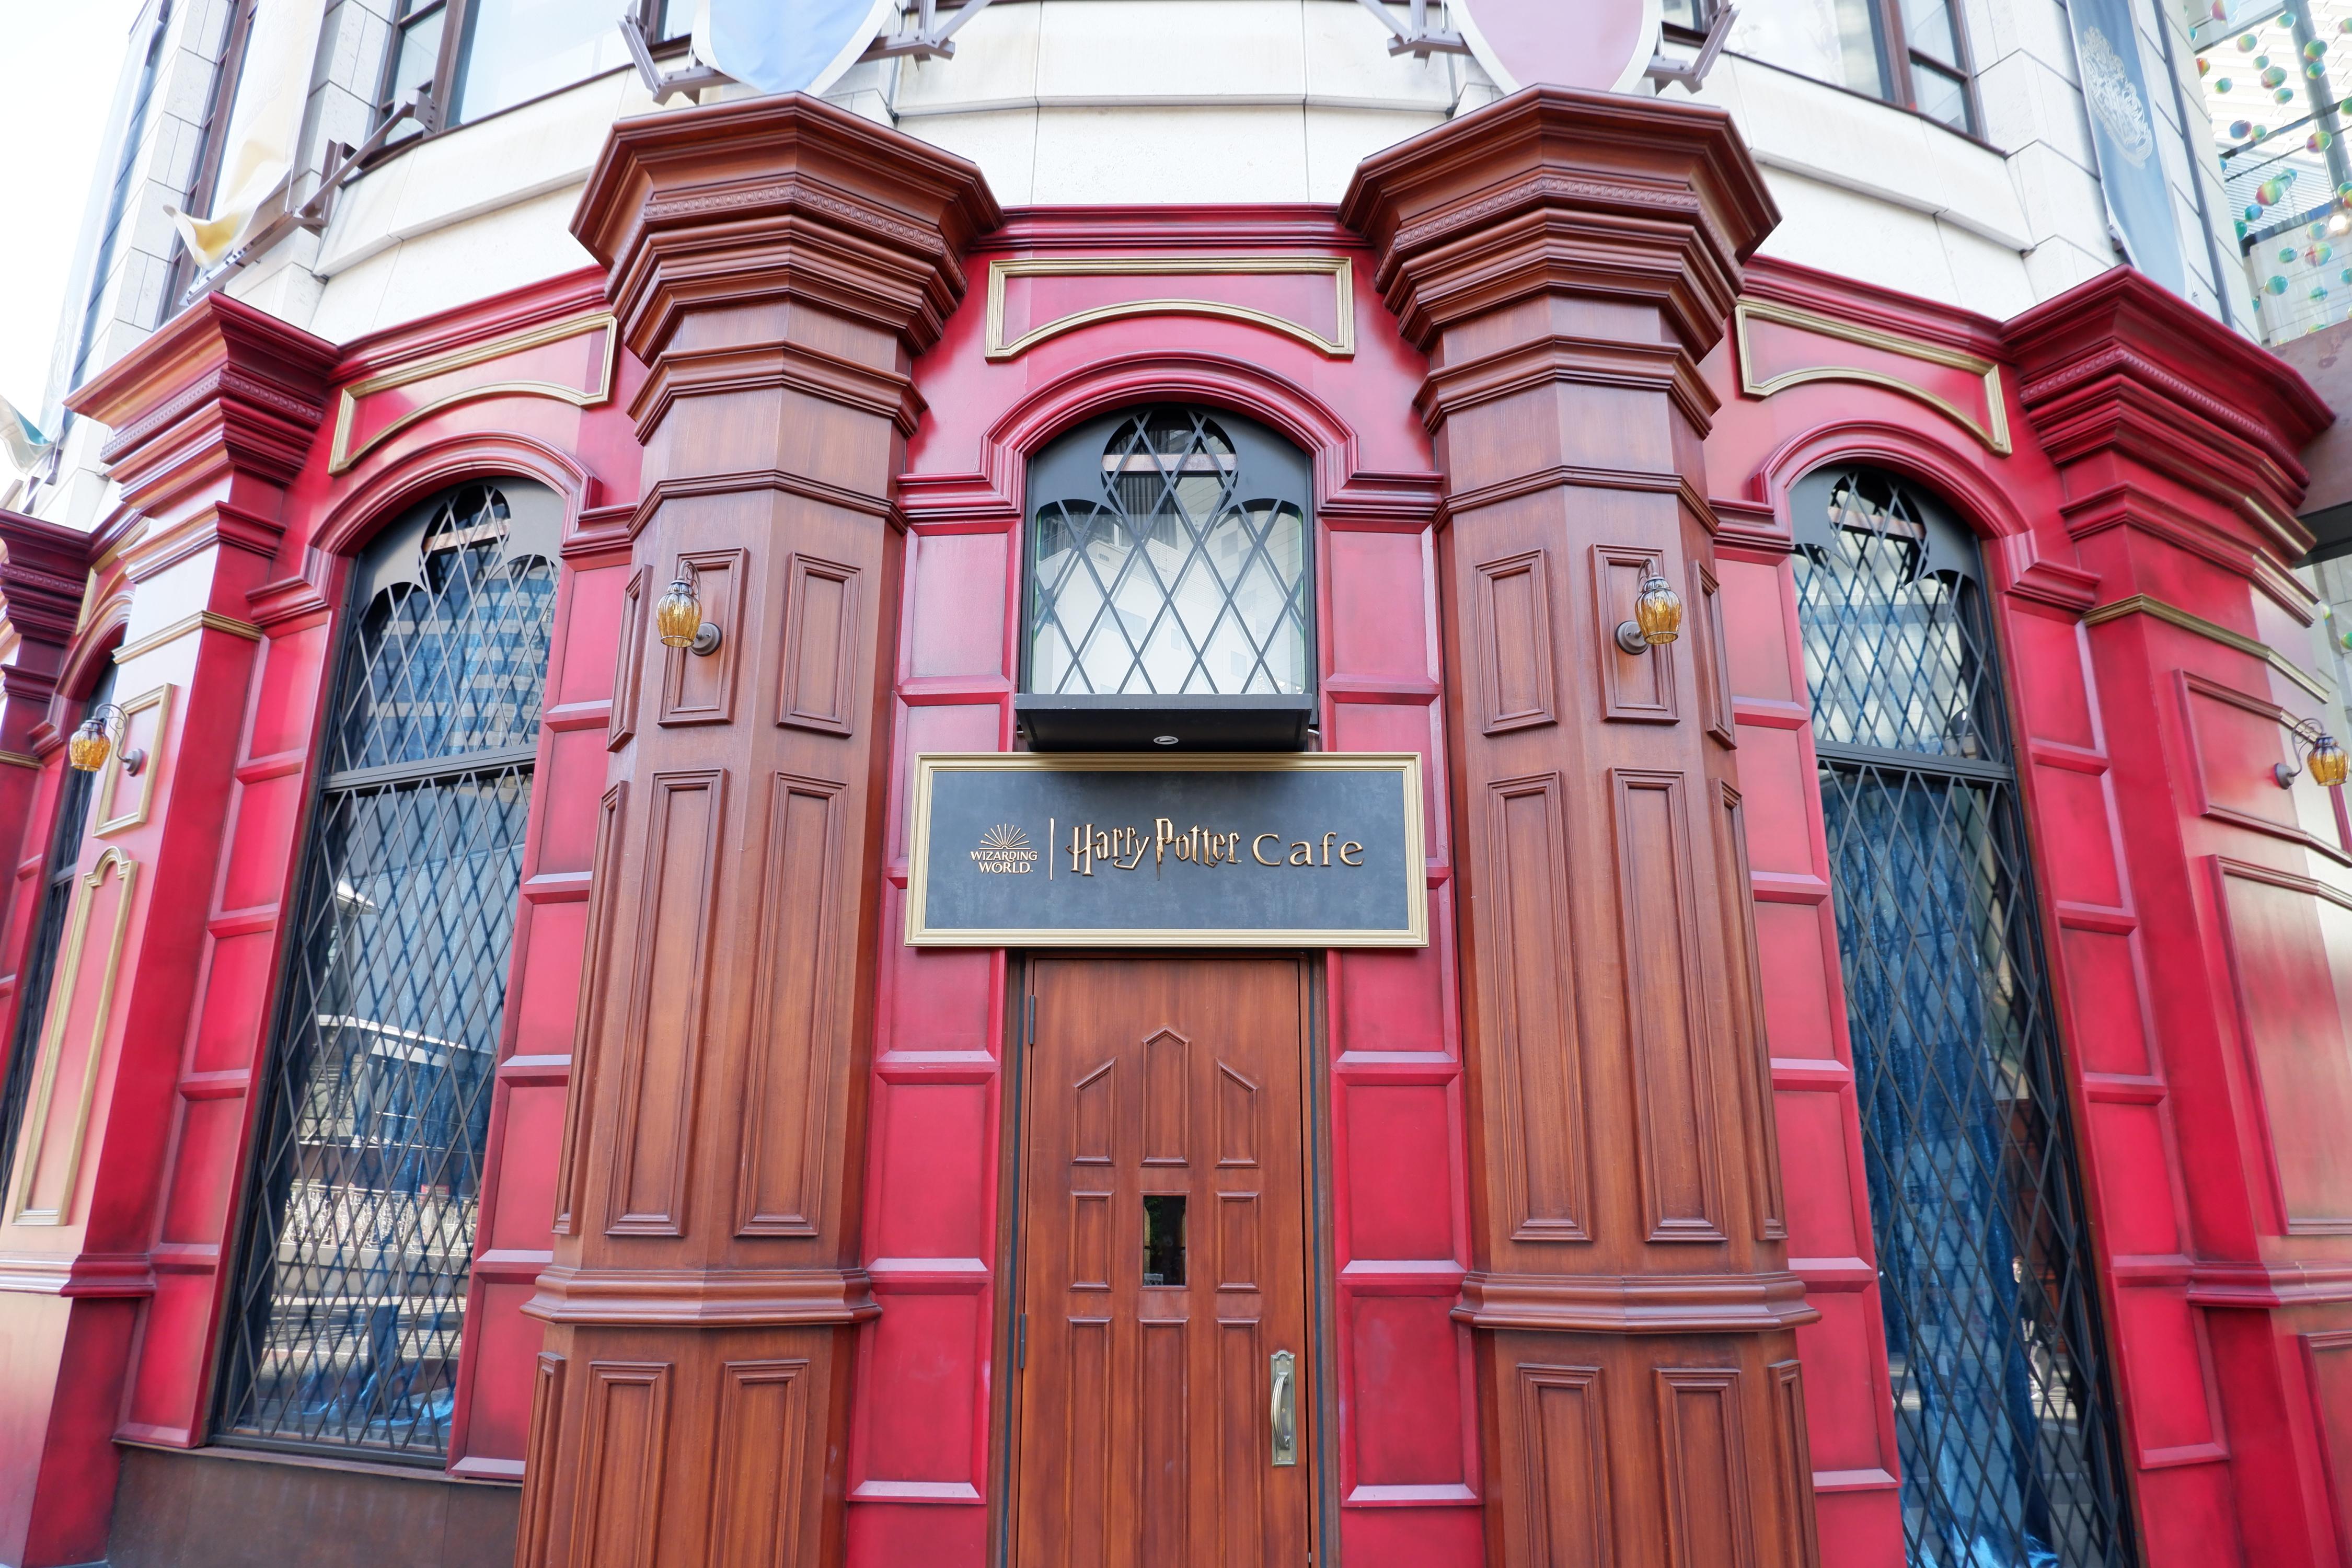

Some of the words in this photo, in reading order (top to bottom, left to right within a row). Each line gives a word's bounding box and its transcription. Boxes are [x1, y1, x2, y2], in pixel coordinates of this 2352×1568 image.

[1066, 824, 1150, 876] Harry
[1154, 817, 1240, 881] Potter
[1252, 832, 1365, 866] Cafe
[970, 851, 1038, 862] WIZARDING
[978, 862, 1031, 873] WORLD
